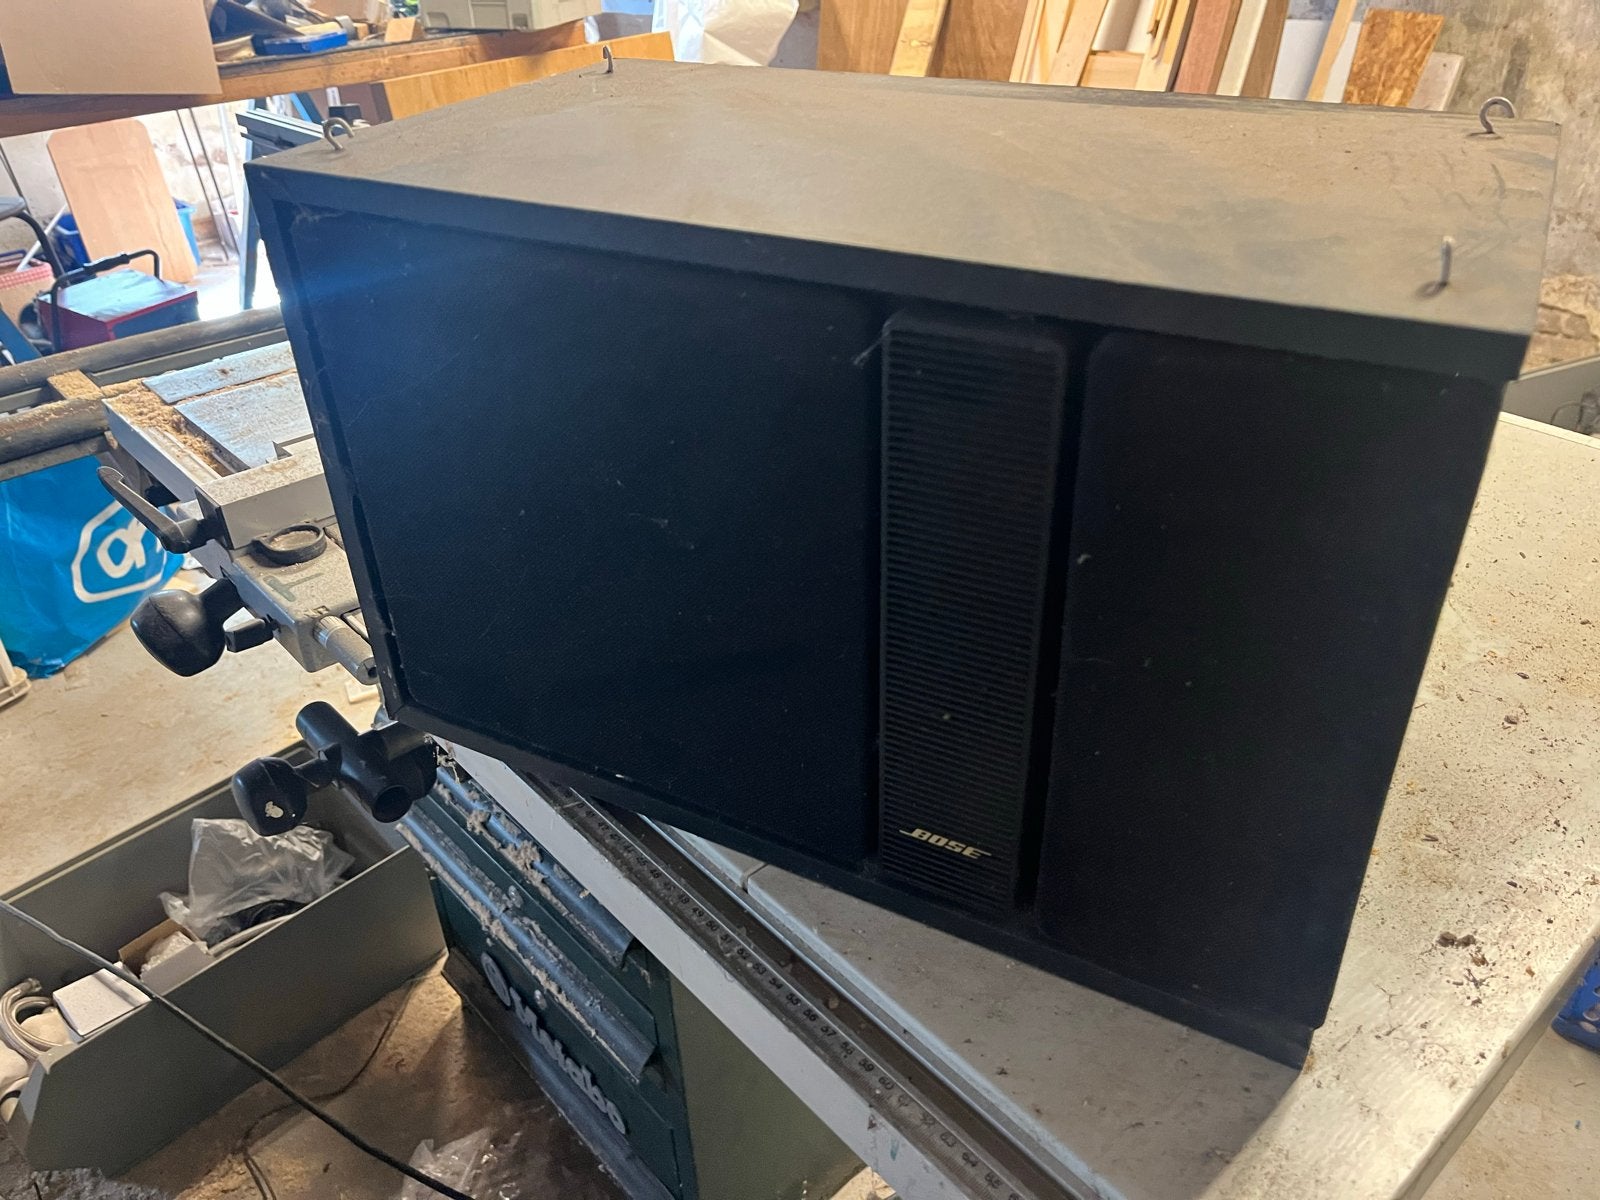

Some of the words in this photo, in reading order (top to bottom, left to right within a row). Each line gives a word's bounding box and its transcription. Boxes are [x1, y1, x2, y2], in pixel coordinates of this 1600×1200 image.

[899, 828, 992, 859] BOSE
[706, 920, 718, 932] 50
[736, 948, 750, 960] 52
[752, 963, 767, 975] 53
[769, 978, 783, 989] 54
[786, 993, 801, 1006] 55
[803, 1009, 818, 1021] 56
[820, 1025, 837, 1037] 57
[841, 1041, 855, 1055] 58
[859, 1058, 875, 1072] 59
[878, 1076, 895, 1090] 60
[962, 1152, 978, 1167] 64
